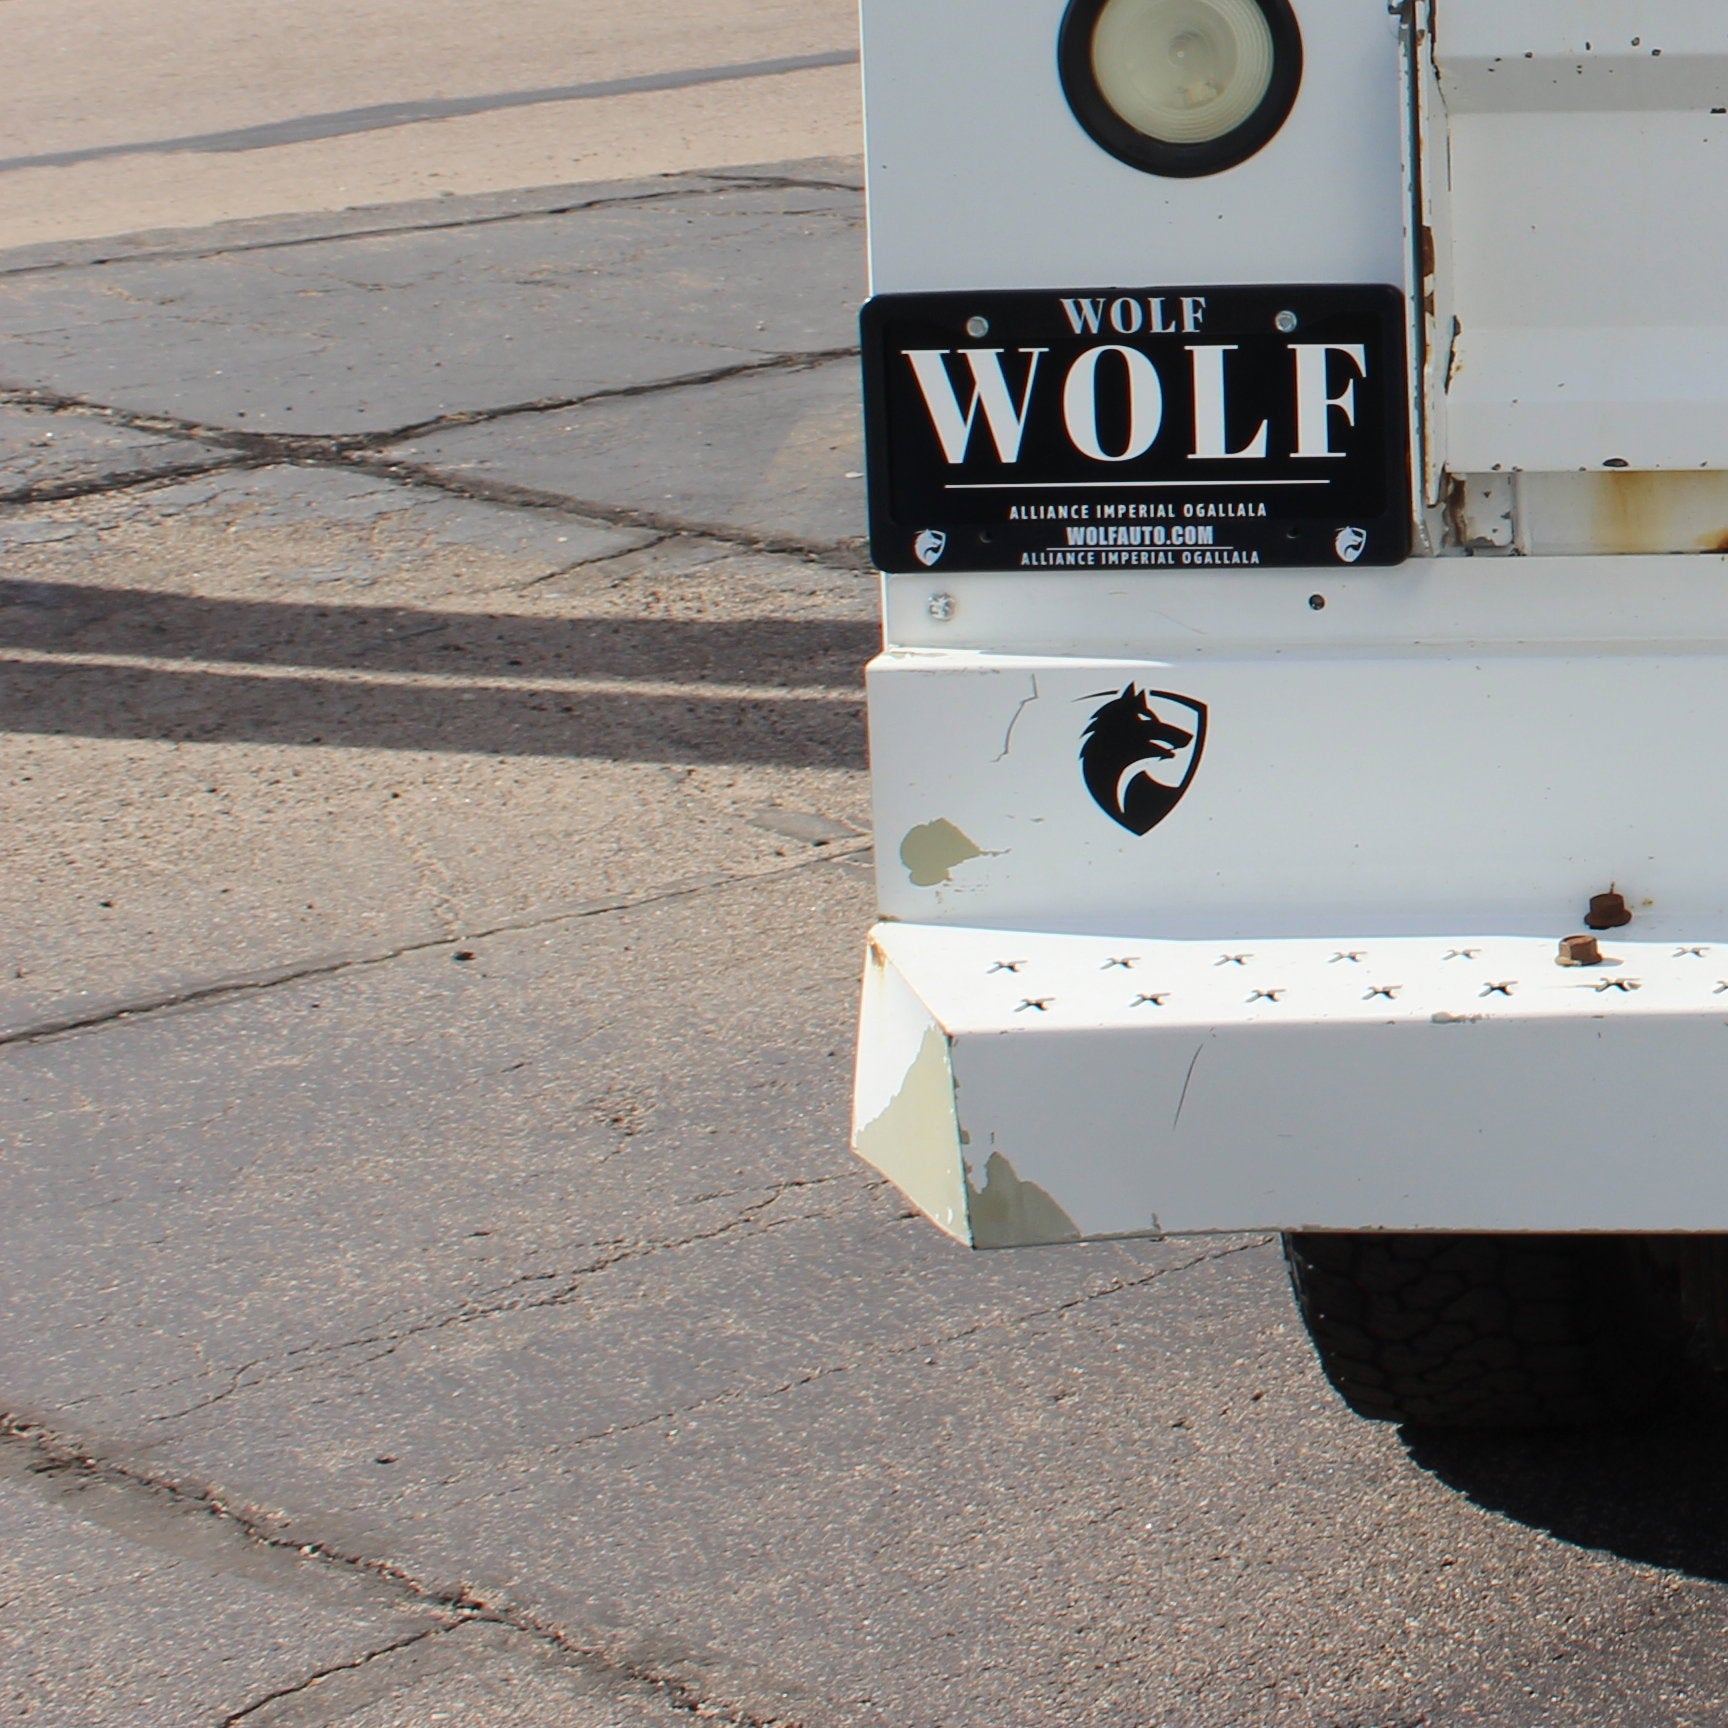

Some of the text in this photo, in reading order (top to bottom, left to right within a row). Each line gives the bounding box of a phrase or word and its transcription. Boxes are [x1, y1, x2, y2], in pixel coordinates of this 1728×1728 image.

[1060, 296, 1208, 335] WOLF
[901, 344, 1367, 465] WOLF
[1009, 502, 1267, 521] ALLIANCE IMPERIAL OGALLALA
[1066, 525, 1213, 547] WOLFAUTO.COM
[1020, 549, 1260, 566] ALLIANCE IMPERIAL OGALLALA
